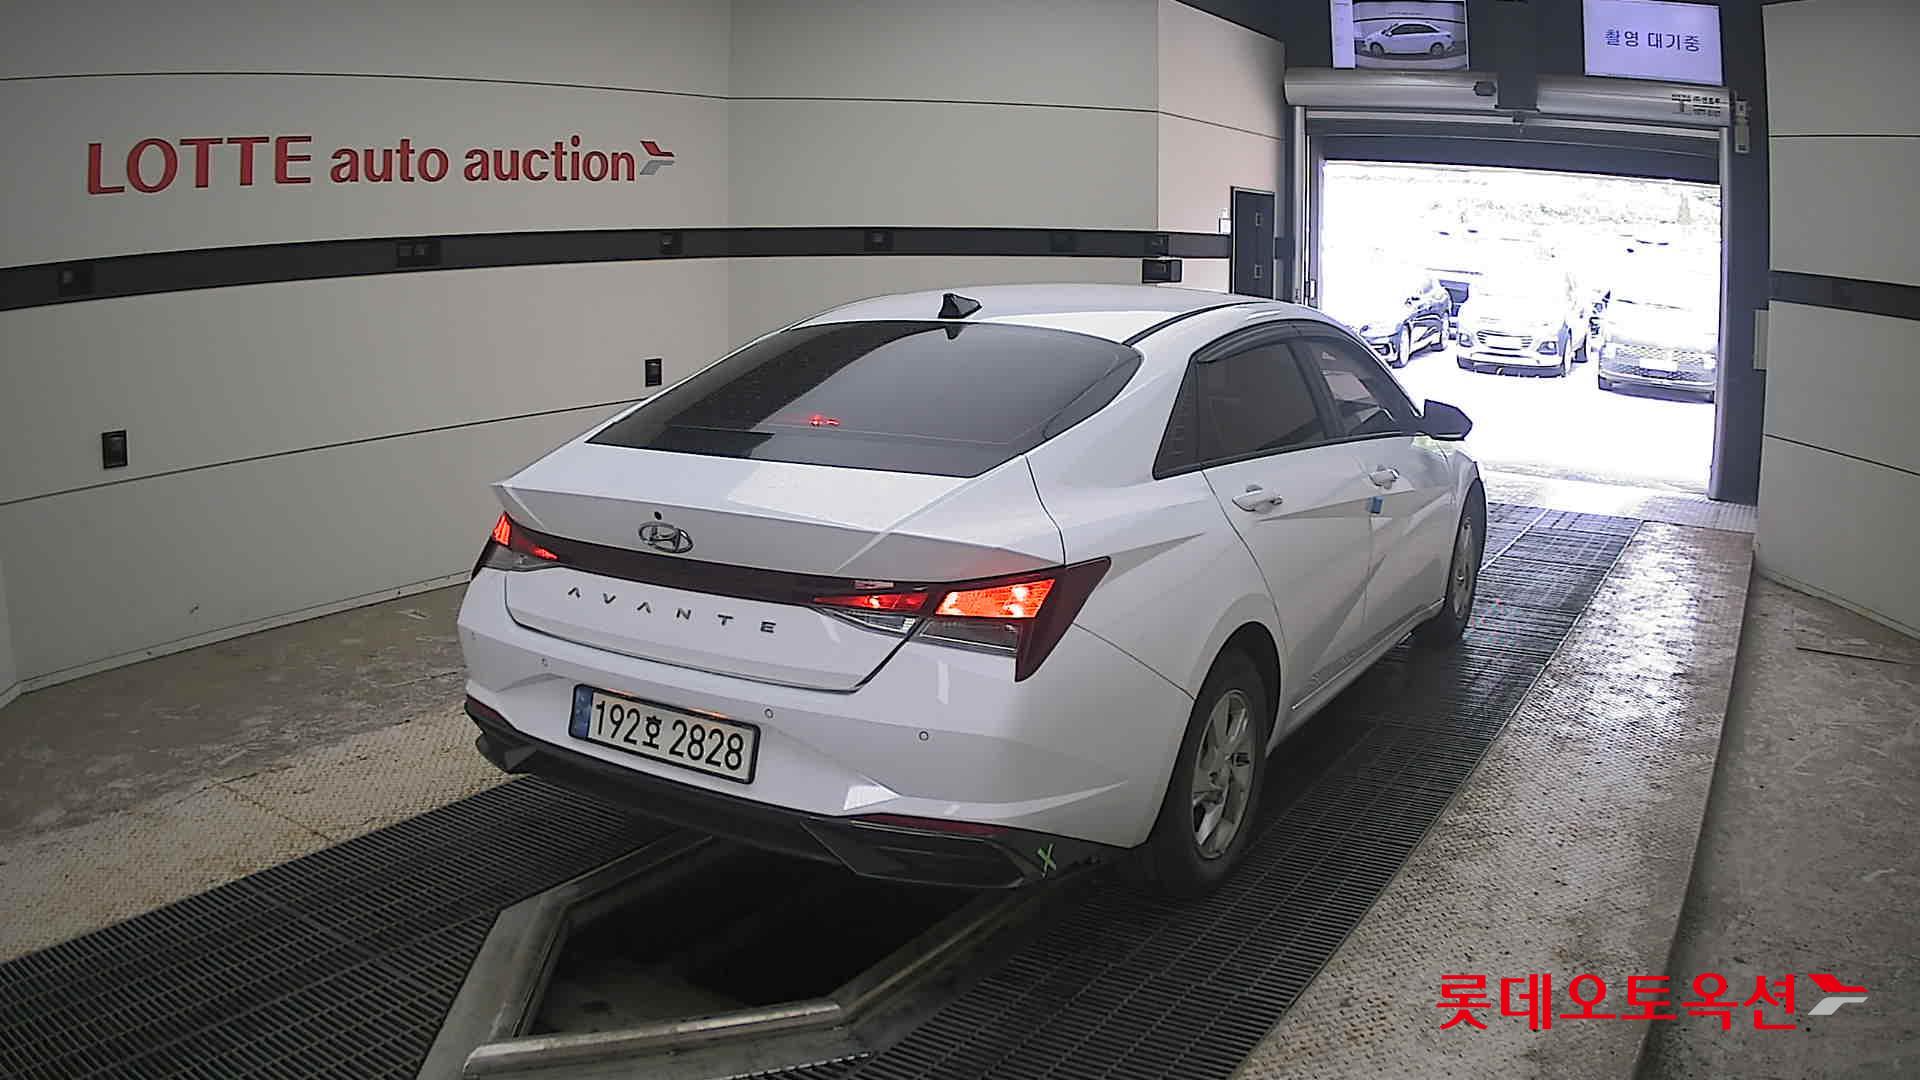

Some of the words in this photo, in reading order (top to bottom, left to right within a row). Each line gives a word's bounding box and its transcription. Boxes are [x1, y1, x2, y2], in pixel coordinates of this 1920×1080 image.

[1647, 32, 1700, 52] 대기중
[87, 135, 312, 195] LOTTE
[330, 138, 449, 183] auto
[463, 135, 636, 182] auction
[567, 587, 776, 633] AVANTE
[596, 700, 662, 750] 192호
[669, 719, 744, 771] 2828
